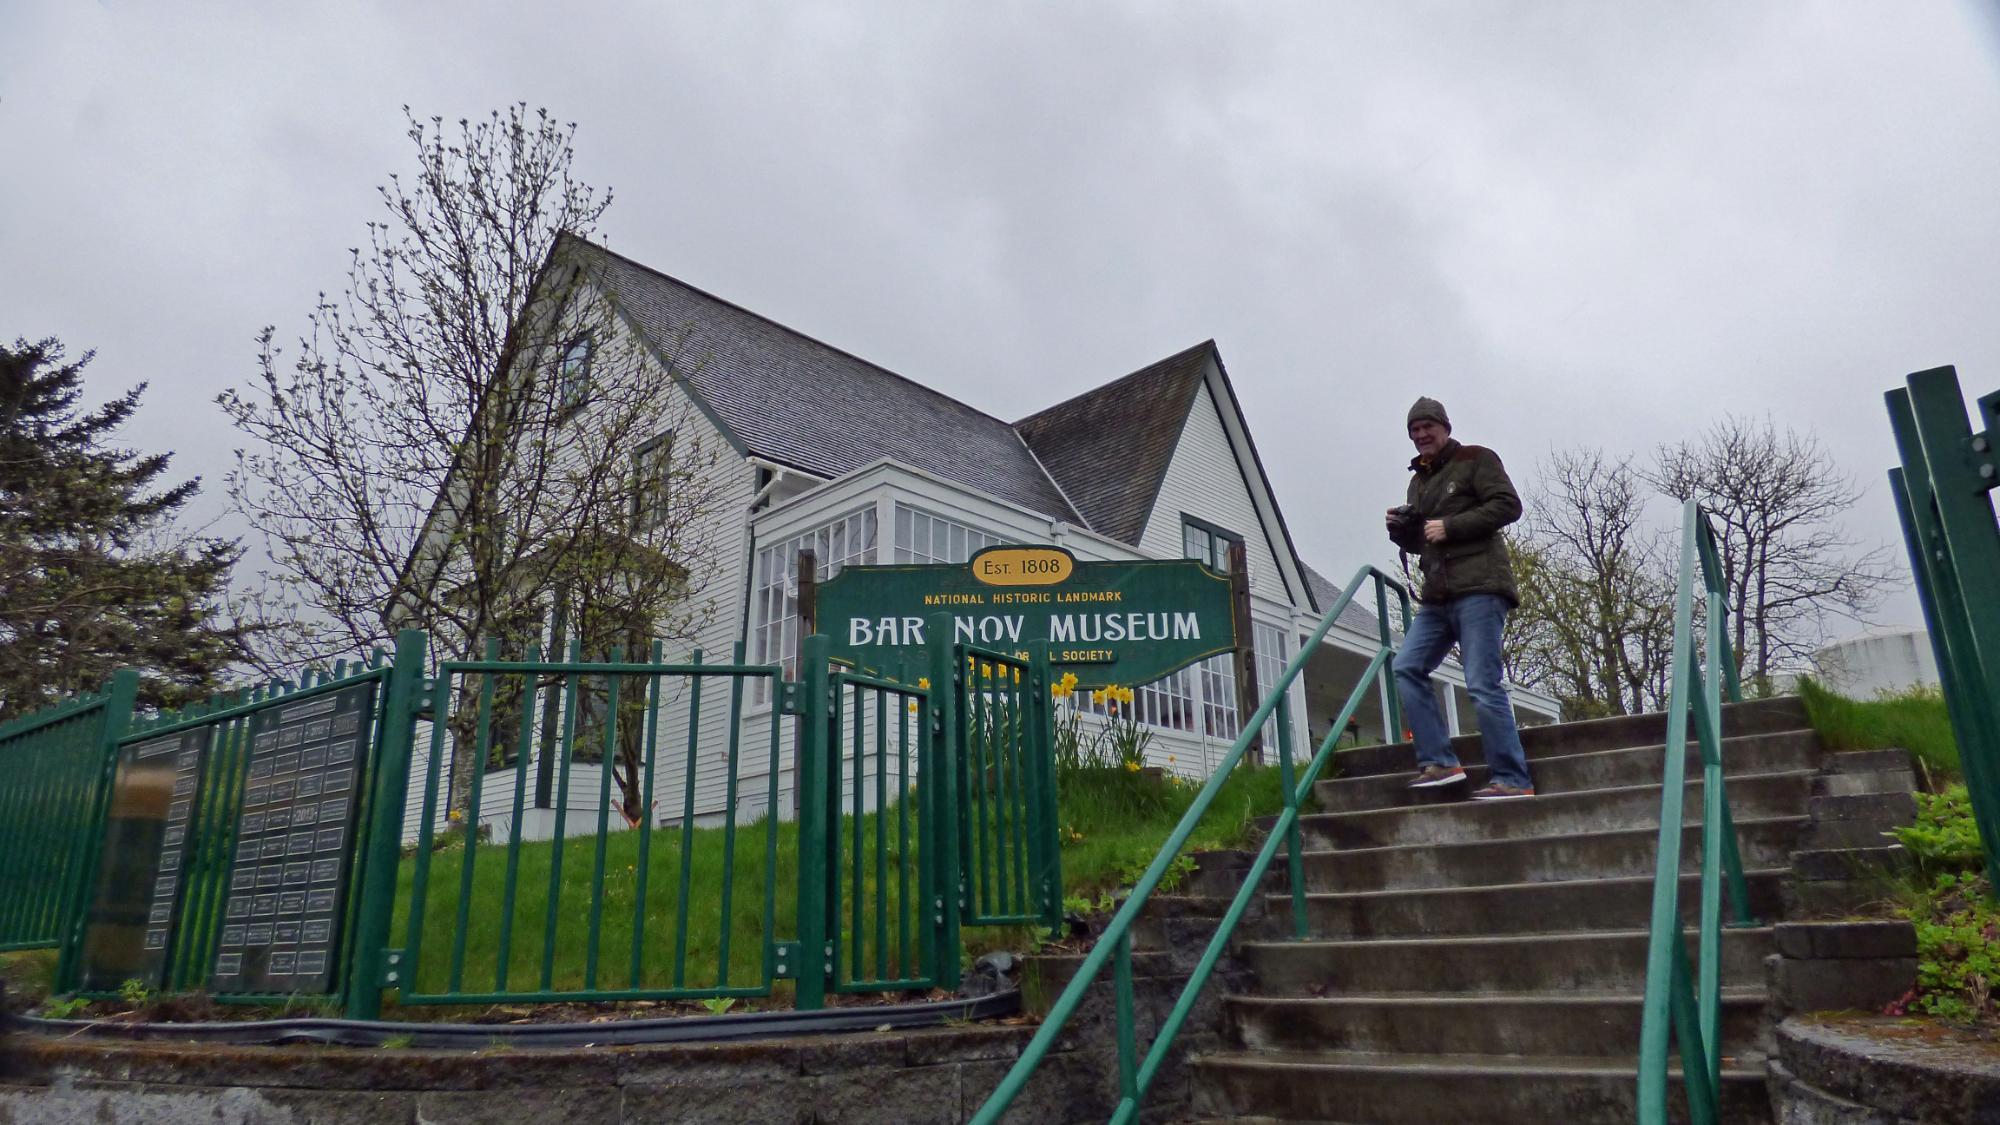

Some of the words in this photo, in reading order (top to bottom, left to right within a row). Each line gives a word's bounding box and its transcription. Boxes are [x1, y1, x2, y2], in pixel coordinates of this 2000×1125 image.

[983, 559, 1011, 575] Est.
[1021, 559, 1060, 574] 1808
[924, 594, 985, 605] NATIONAL
[993, 593, 1050, 604] HISTORIC
[1057, 591, 1122, 603] LANDMARK
[849, 615, 1025, 646] BARNOV
[1050, 612, 1201, 643] MUSEUM
[1062, 650, 1113, 661] SOCIETY
